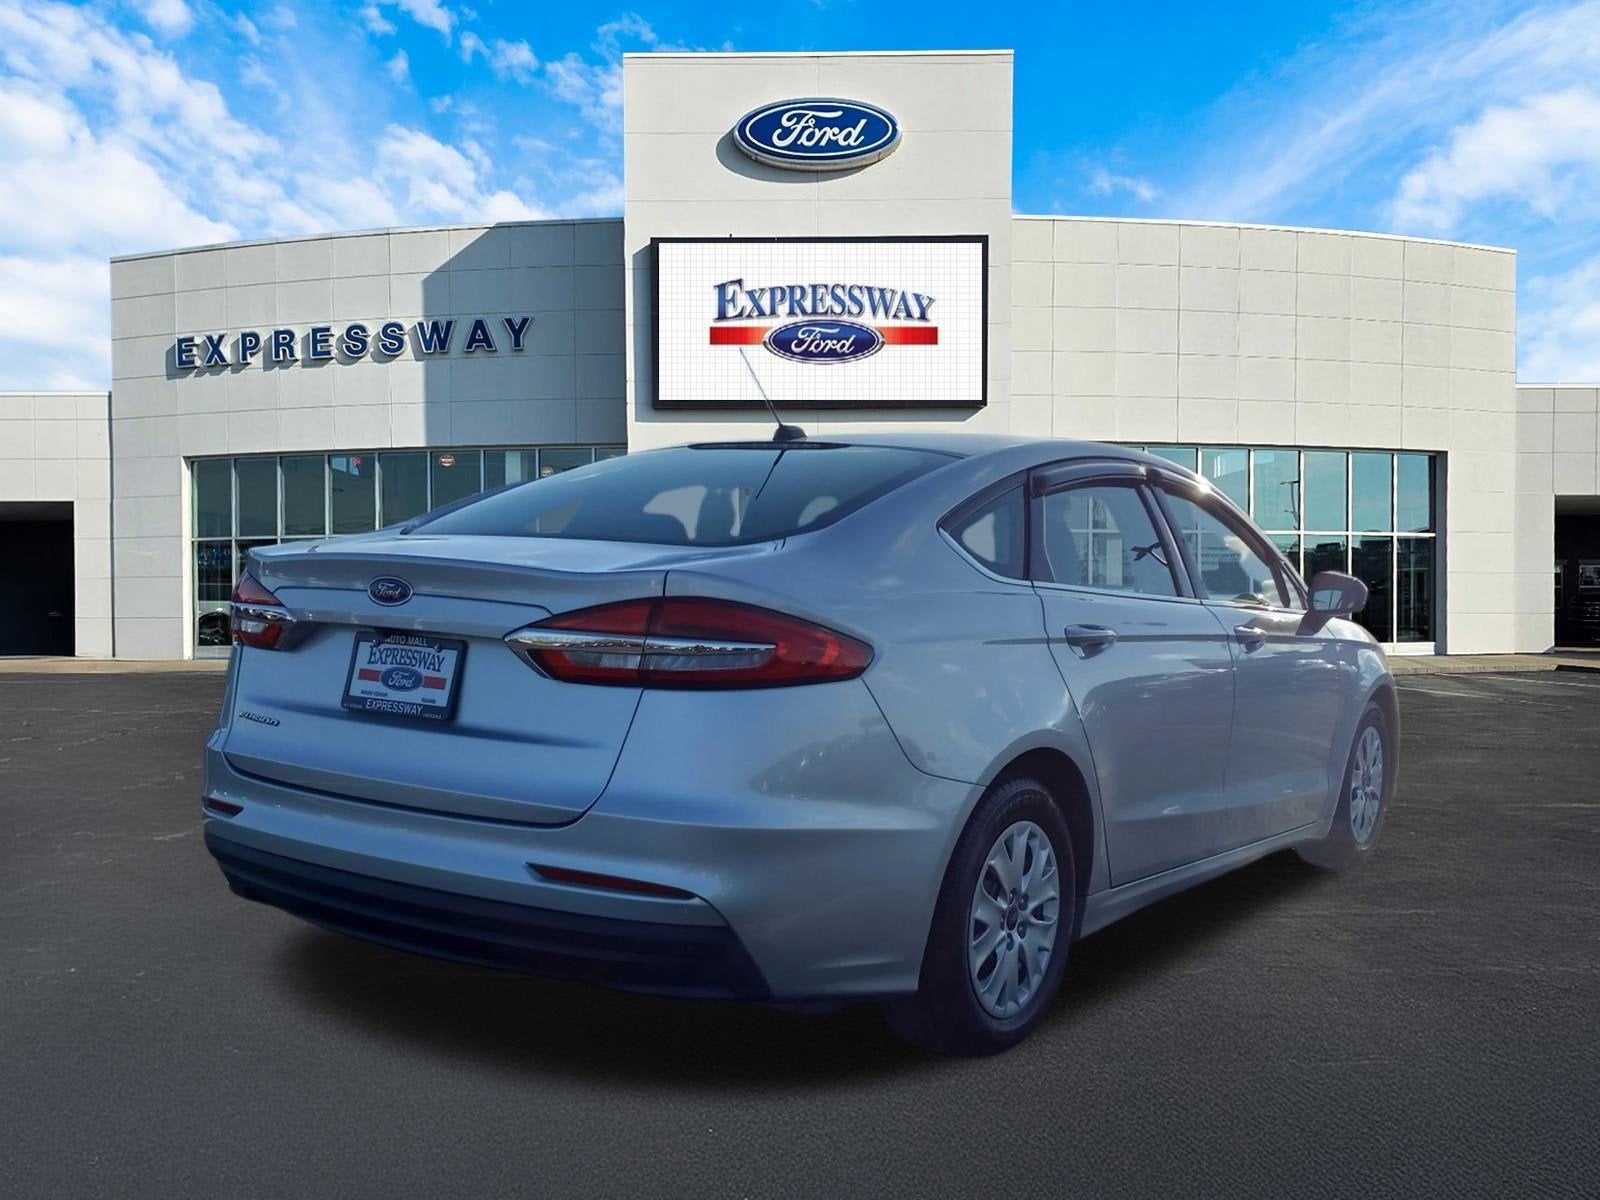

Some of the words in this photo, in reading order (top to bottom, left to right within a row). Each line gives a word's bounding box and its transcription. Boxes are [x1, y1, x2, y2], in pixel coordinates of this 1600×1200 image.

[772, 110, 867, 147] Ford
[713, 278, 935, 322] EXPRESSWAY
[175, 317, 532, 368] EXPRESSWAY
[791, 327, 855, 354] Ford
[385, 635, 406, 644] AUTO
[408, 636, 428, 646] MALL
[367, 645, 445, 672] EXPRESSWAY
[388, 670, 415, 687] Ford
[366, 699, 423, 715] EXPRESSWAY
